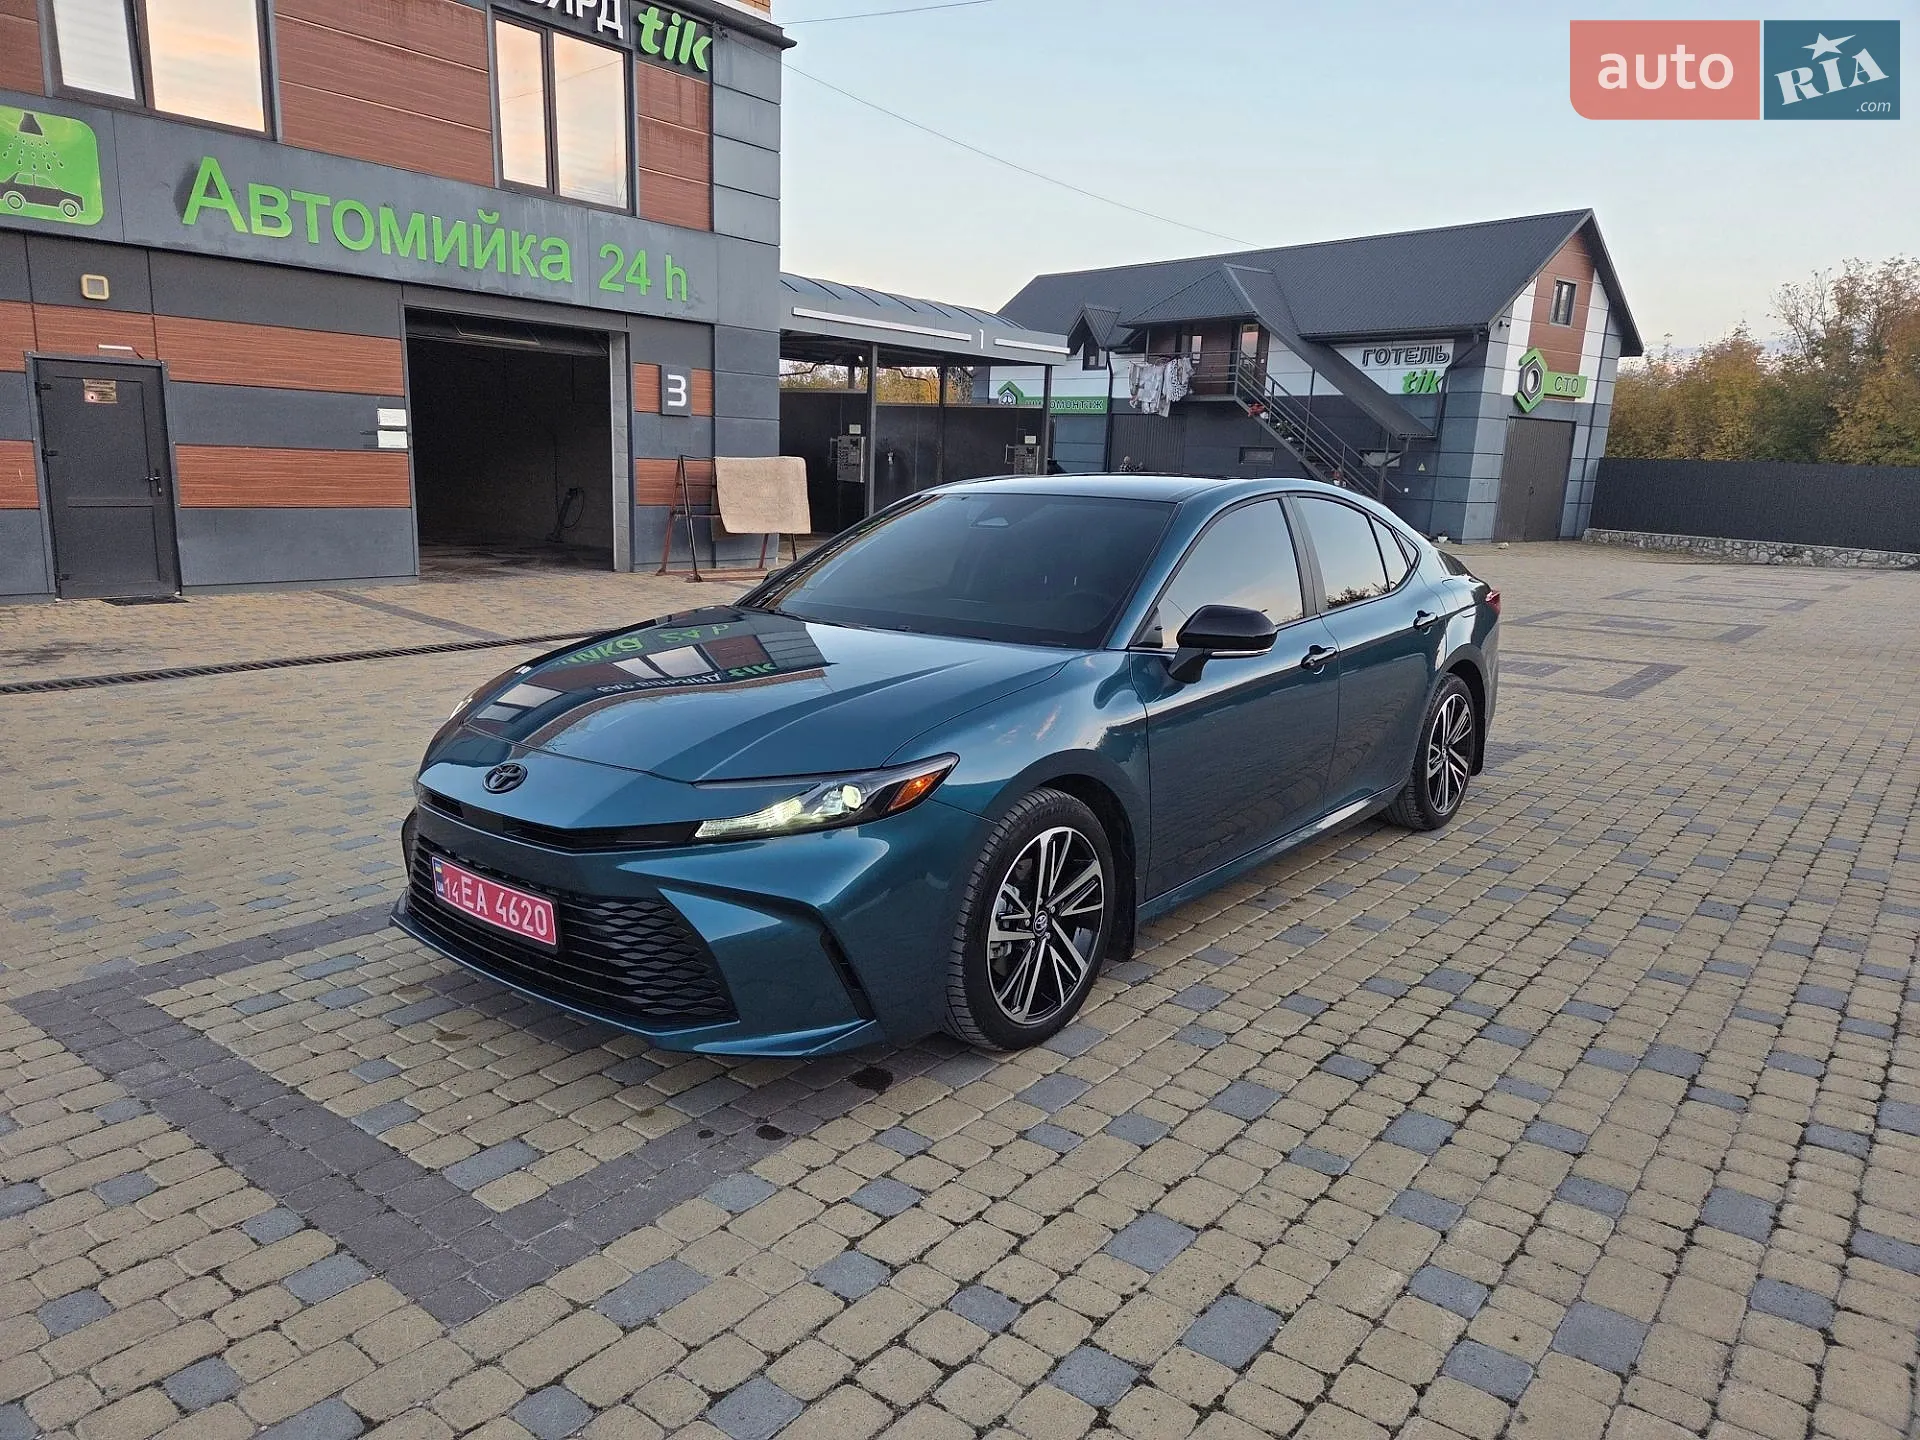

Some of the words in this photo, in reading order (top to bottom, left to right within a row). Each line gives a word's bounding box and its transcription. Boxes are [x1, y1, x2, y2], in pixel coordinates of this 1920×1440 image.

[637, 6, 712, 72] tik
[599, 243, 652, 296] 24
[665, 254, 688, 302] h
[1362, 344, 1450, 367] ГОТЕЛЬ
[667, 374, 687, 407] 3
[1403, 369, 1442, 394] tik
[1554, 376, 1579, 394] СТО
[495, 892, 548, 936] 4620
